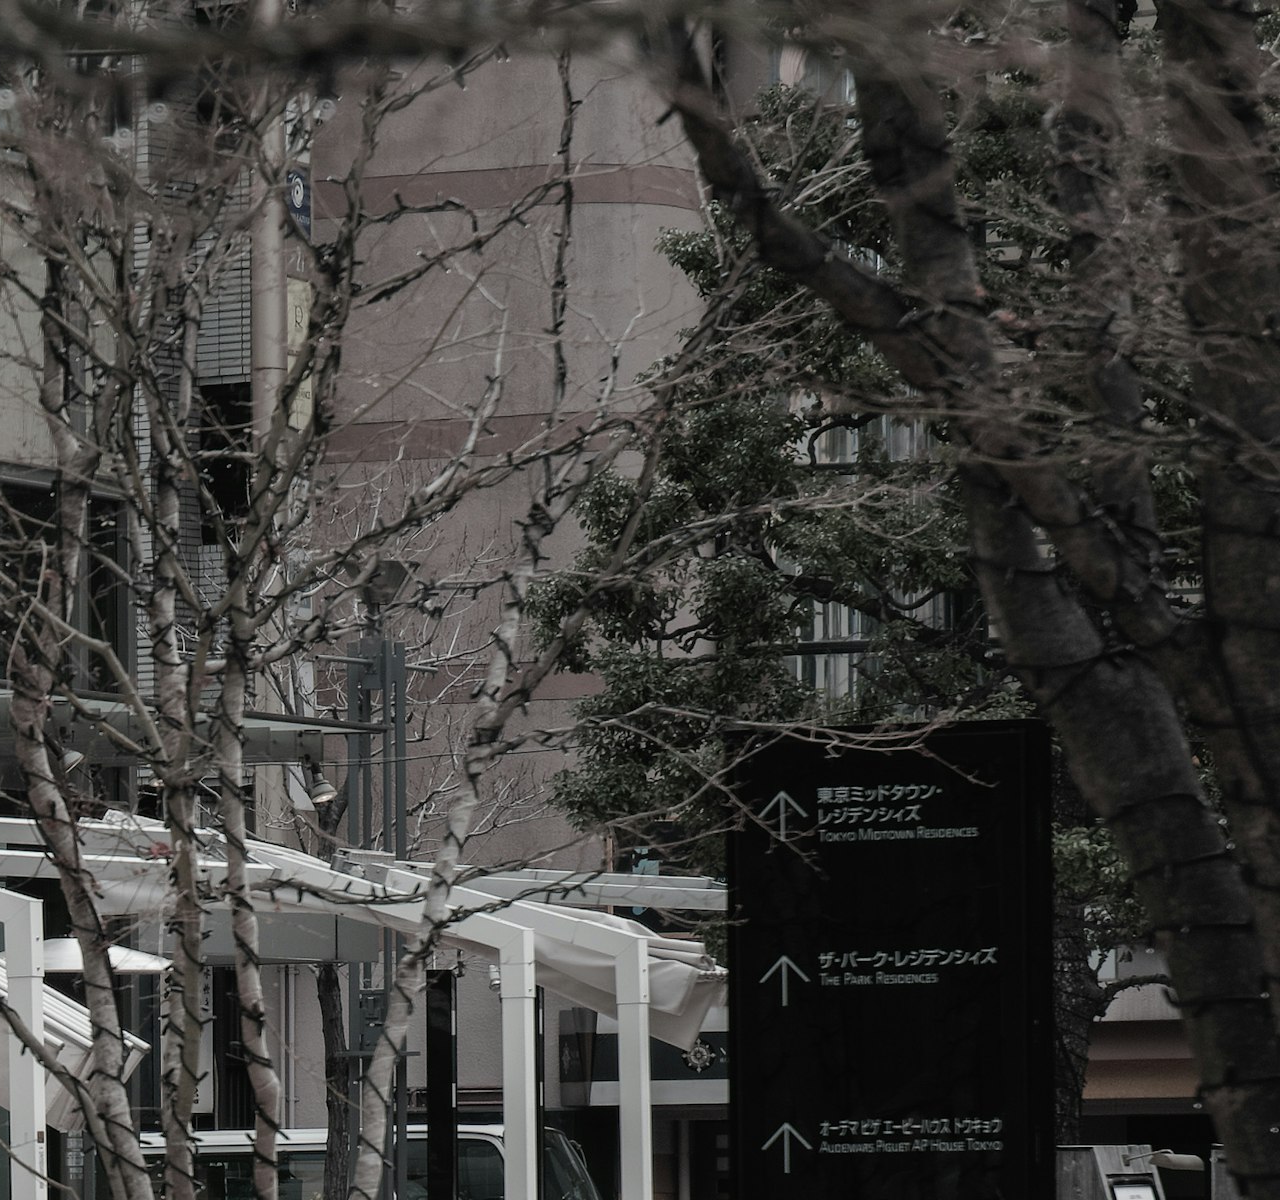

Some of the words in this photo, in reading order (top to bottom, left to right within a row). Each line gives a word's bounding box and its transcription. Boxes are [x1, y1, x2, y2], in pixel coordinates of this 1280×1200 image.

[817, 804, 923, 825] レジデンシィズ
